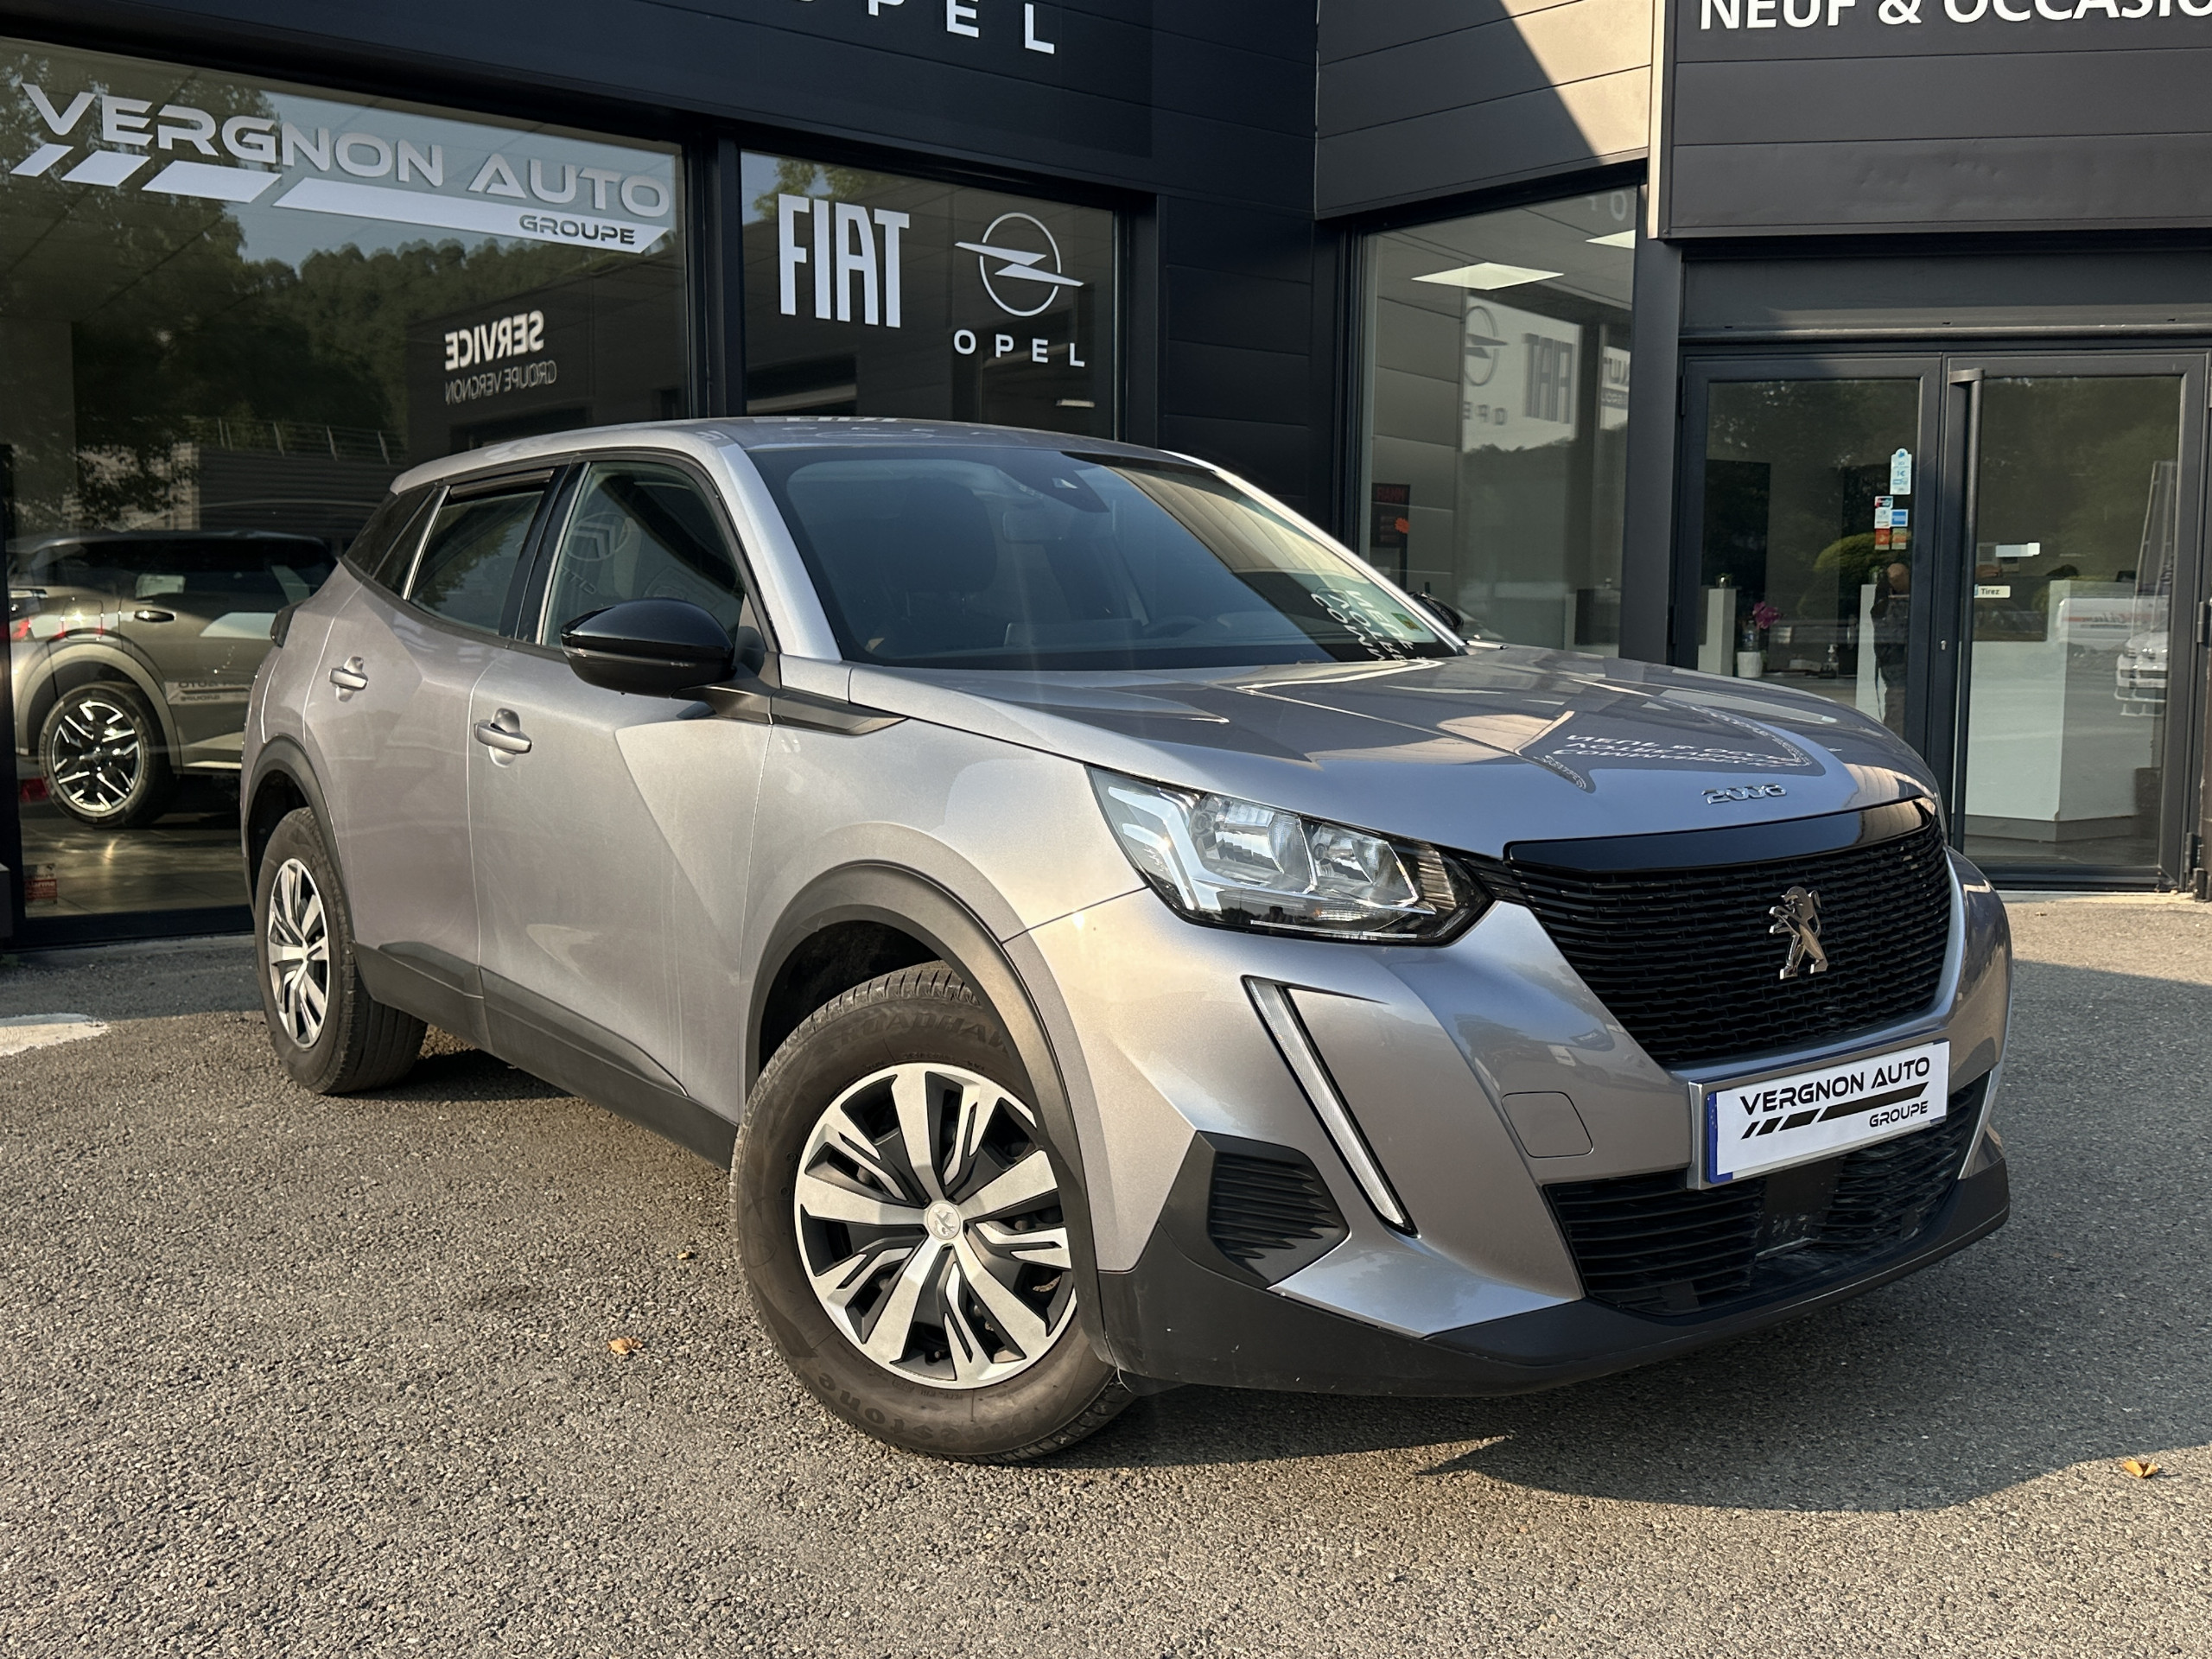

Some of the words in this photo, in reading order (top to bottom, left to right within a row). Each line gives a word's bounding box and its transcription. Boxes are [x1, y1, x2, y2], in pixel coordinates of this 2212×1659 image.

[21, 83, 444, 187] VERGNON
[467, 153, 671, 219] AUTO
[518, 214, 636, 245] GROUPE
[778, 193, 910, 328] FIAT
[953, 329, 1085, 367] OPEL
[1701, 783, 1788, 805] 2008
[1739, 1071, 1865, 1116] VERGNON
[1871, 1057, 1930, 1090] AUTO
[1869, 1100, 1929, 1128] GROUPE
